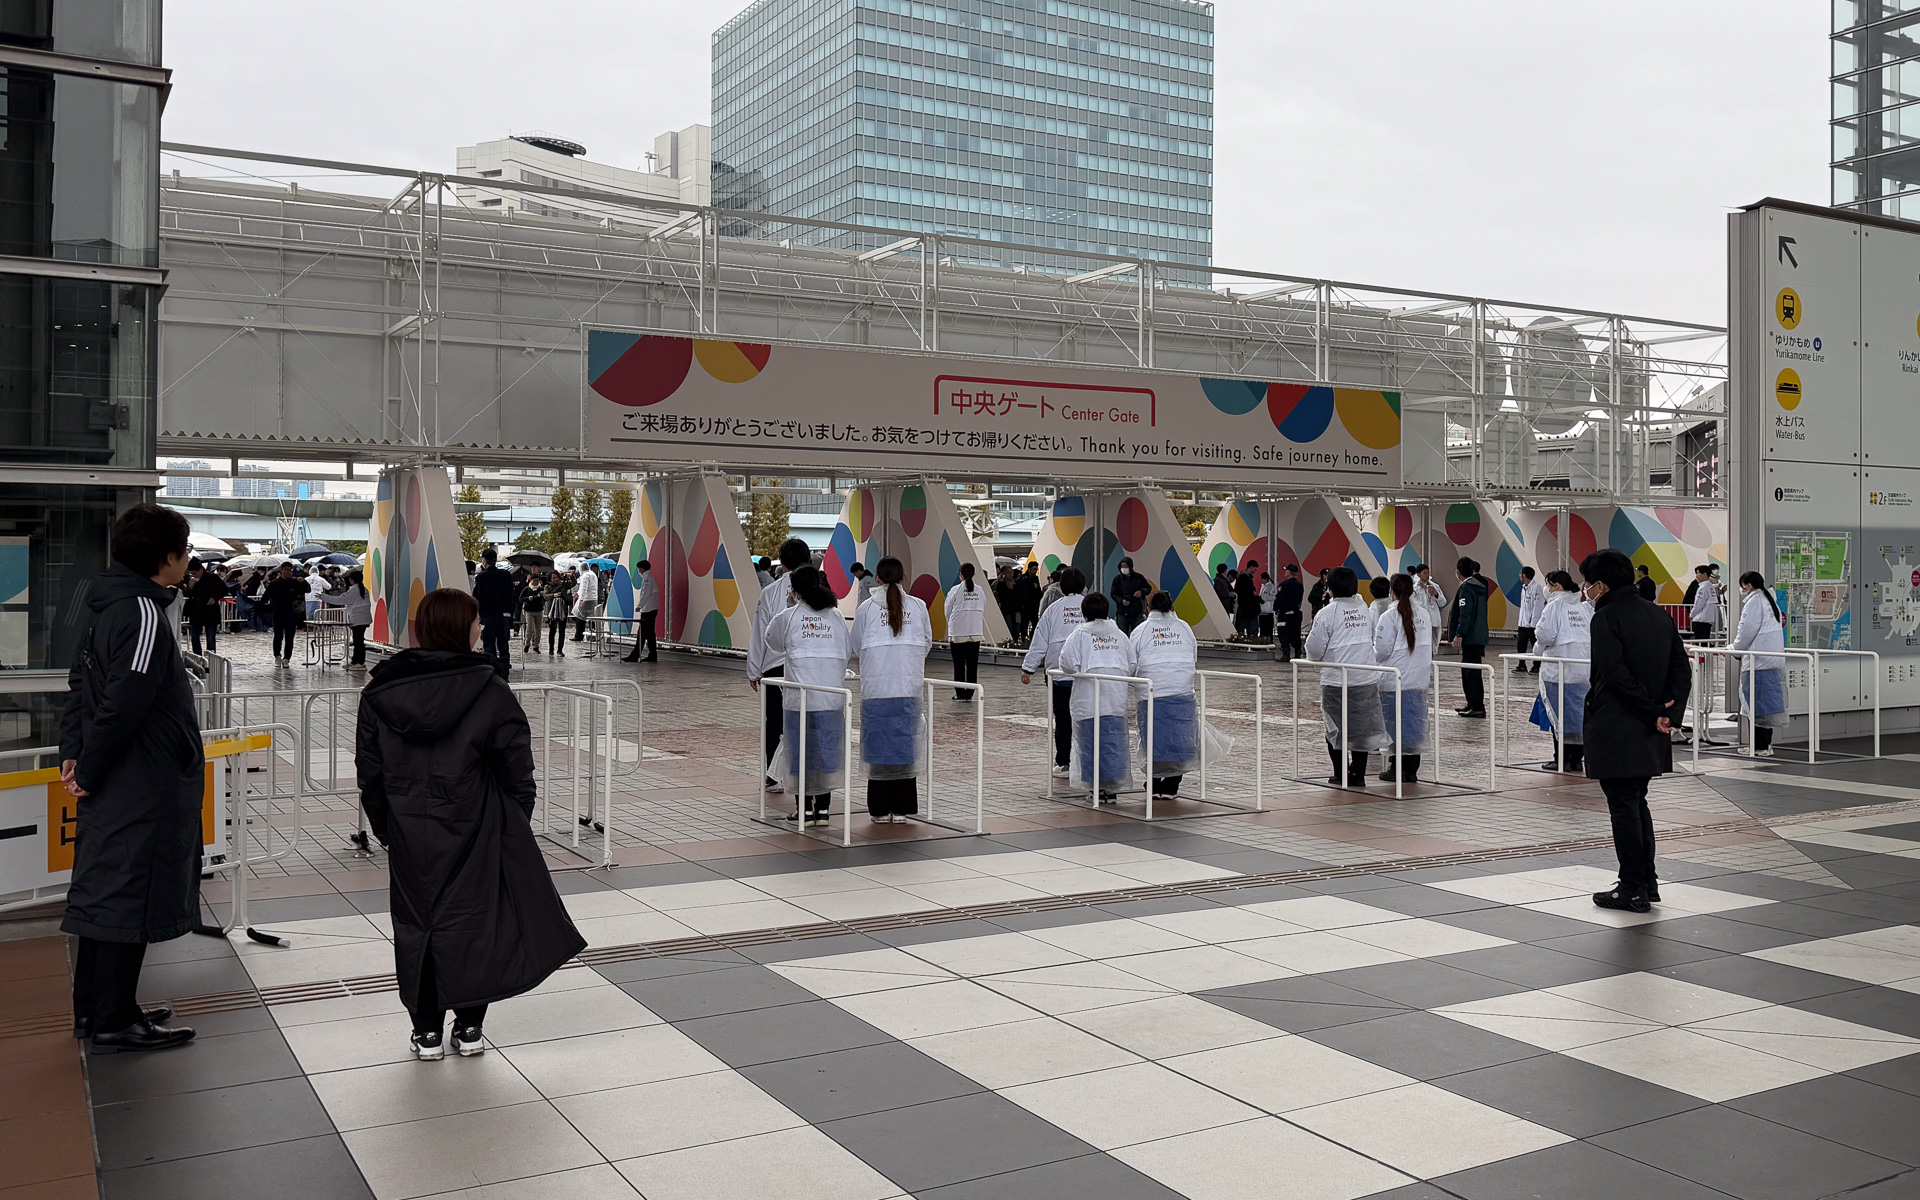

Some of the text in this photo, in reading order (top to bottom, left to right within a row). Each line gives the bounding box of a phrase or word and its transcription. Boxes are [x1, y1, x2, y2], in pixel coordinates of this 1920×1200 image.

[1775, 335, 1811, 348] ゆりかもめ
[1775, 348, 1825, 363] Yurikamome Line
[1898, 350, 1920, 361] りんか
[951, 388, 1140, 424] 中央ゲート Center Gate
[1775, 415, 1805, 427] 水上バス
[1080, 436, 1126, 455] Thank
[1132, 442, 1159, 459] you
[1165, 439, 1186, 457] for
[1192, 442, 1246, 464] visiting.
[1252, 445, 1283, 462] Safe
[1288, 449, 1339, 468] journey
[1344, 449, 1383, 467] home.
[1879, 492, 1887, 505] 2F
[801, 615, 822, 623] Japan
[802, 623, 831, 632] Mobility
[802, 631, 821, 639] Show
[1153, 632, 1180, 640] Mobility
